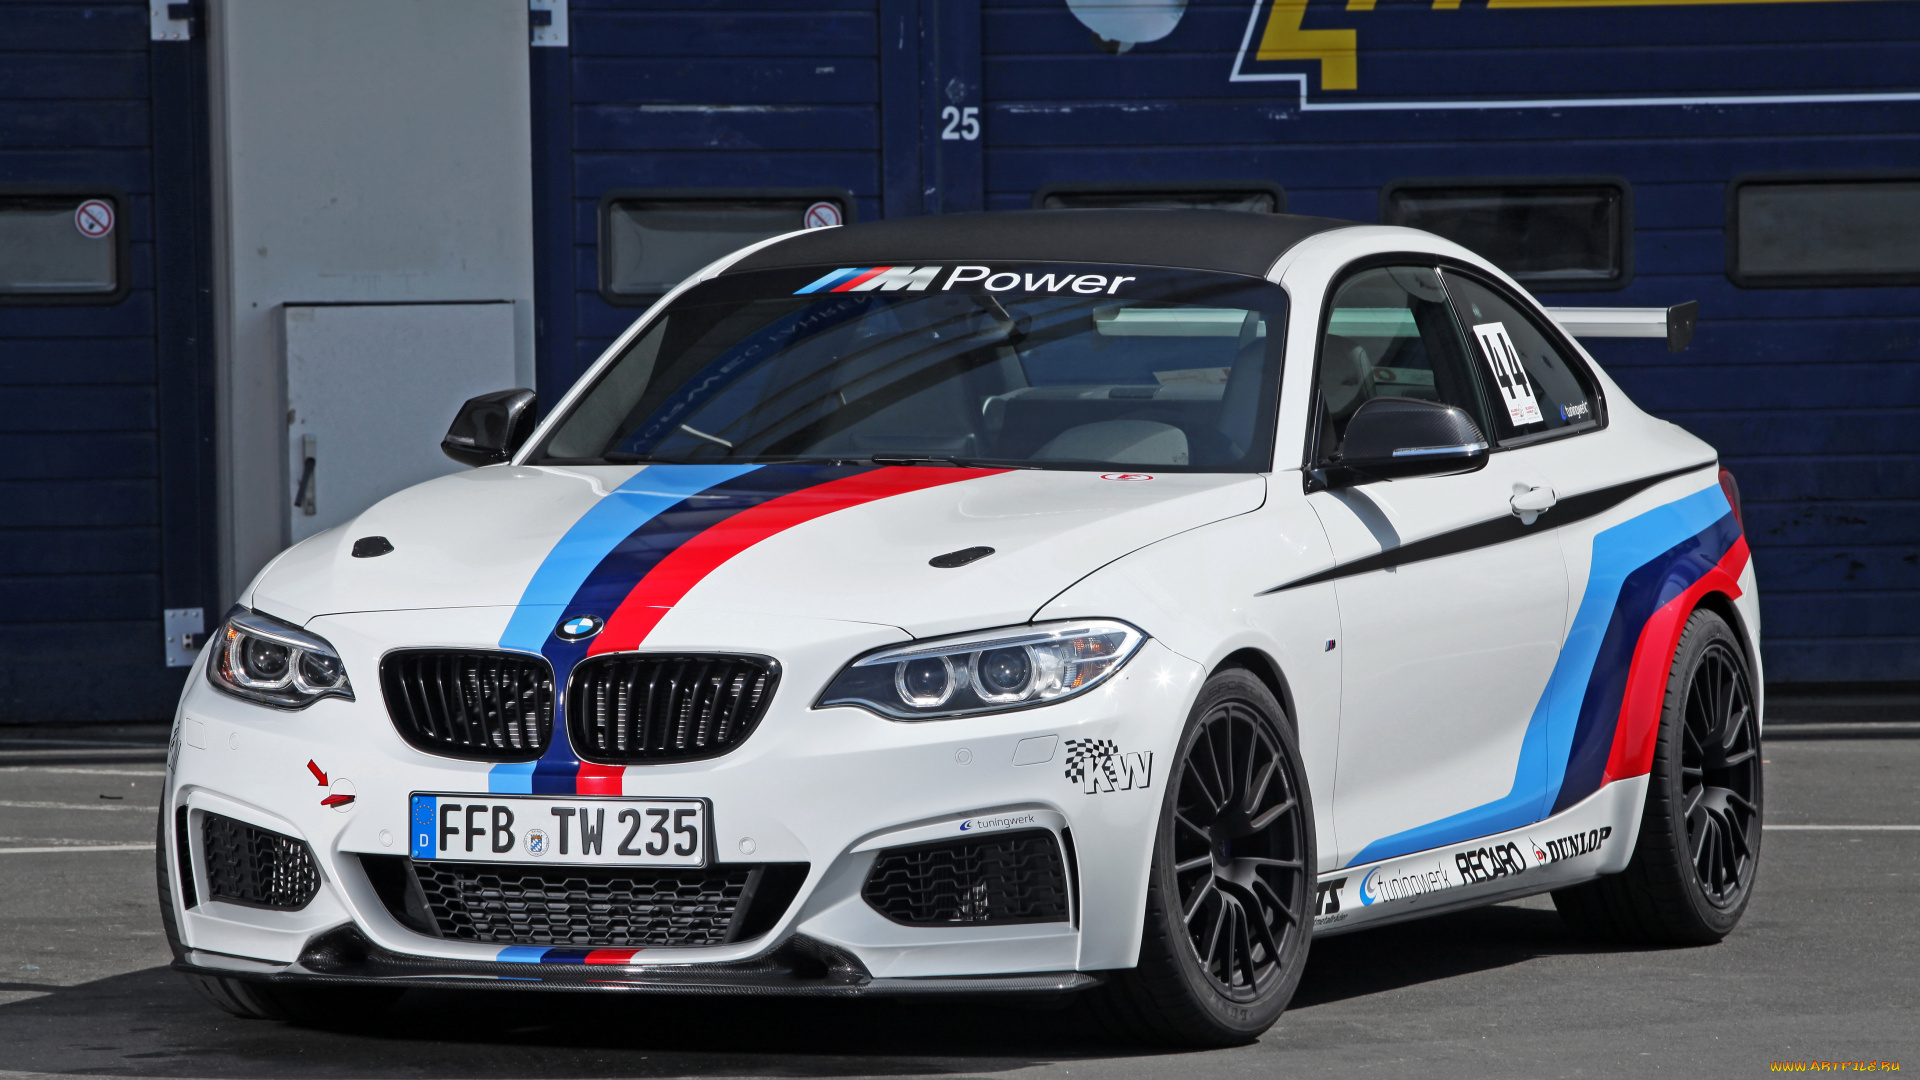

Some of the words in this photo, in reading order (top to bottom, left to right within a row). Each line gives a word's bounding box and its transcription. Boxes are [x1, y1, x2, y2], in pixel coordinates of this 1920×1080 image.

[942, 105, 980, 141] 25
[942, 265, 1136, 295] Power
[1481, 332, 1531, 400] 44
[1083, 750, 1154, 795] KW
[419, 833, 429, 848] D
[439, 803, 516, 853] FFB
[551, 806, 605, 856] TW
[617, 807, 698, 857] 235
[977, 814, 1035, 829] tuningwerk
[1455, 841, 1527, 886] RECARO
[1546, 826, 1612, 864] DUNLOP
[1315, 877, 1349, 916] TS
[1377, 861, 1452, 903] tuningwerk
